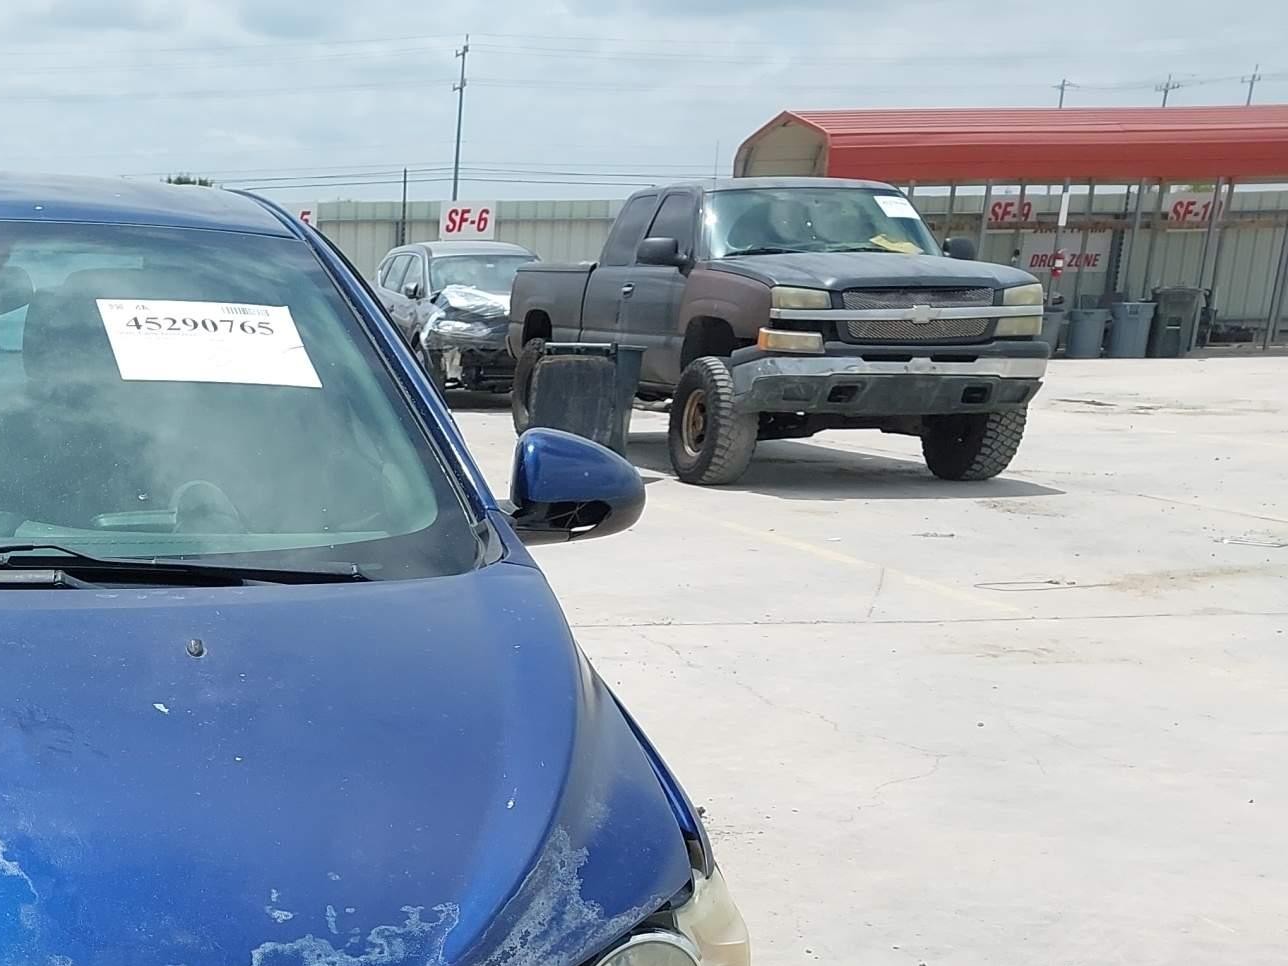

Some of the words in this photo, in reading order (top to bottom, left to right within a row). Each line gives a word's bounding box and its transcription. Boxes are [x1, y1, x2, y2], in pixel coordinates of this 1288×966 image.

[445, 208, 490, 233] SF-6
[988, 201, 1032, 221] SF-9
[1067, 253, 1101, 267] ZONE
[125, 316, 275, 336] 45290765
